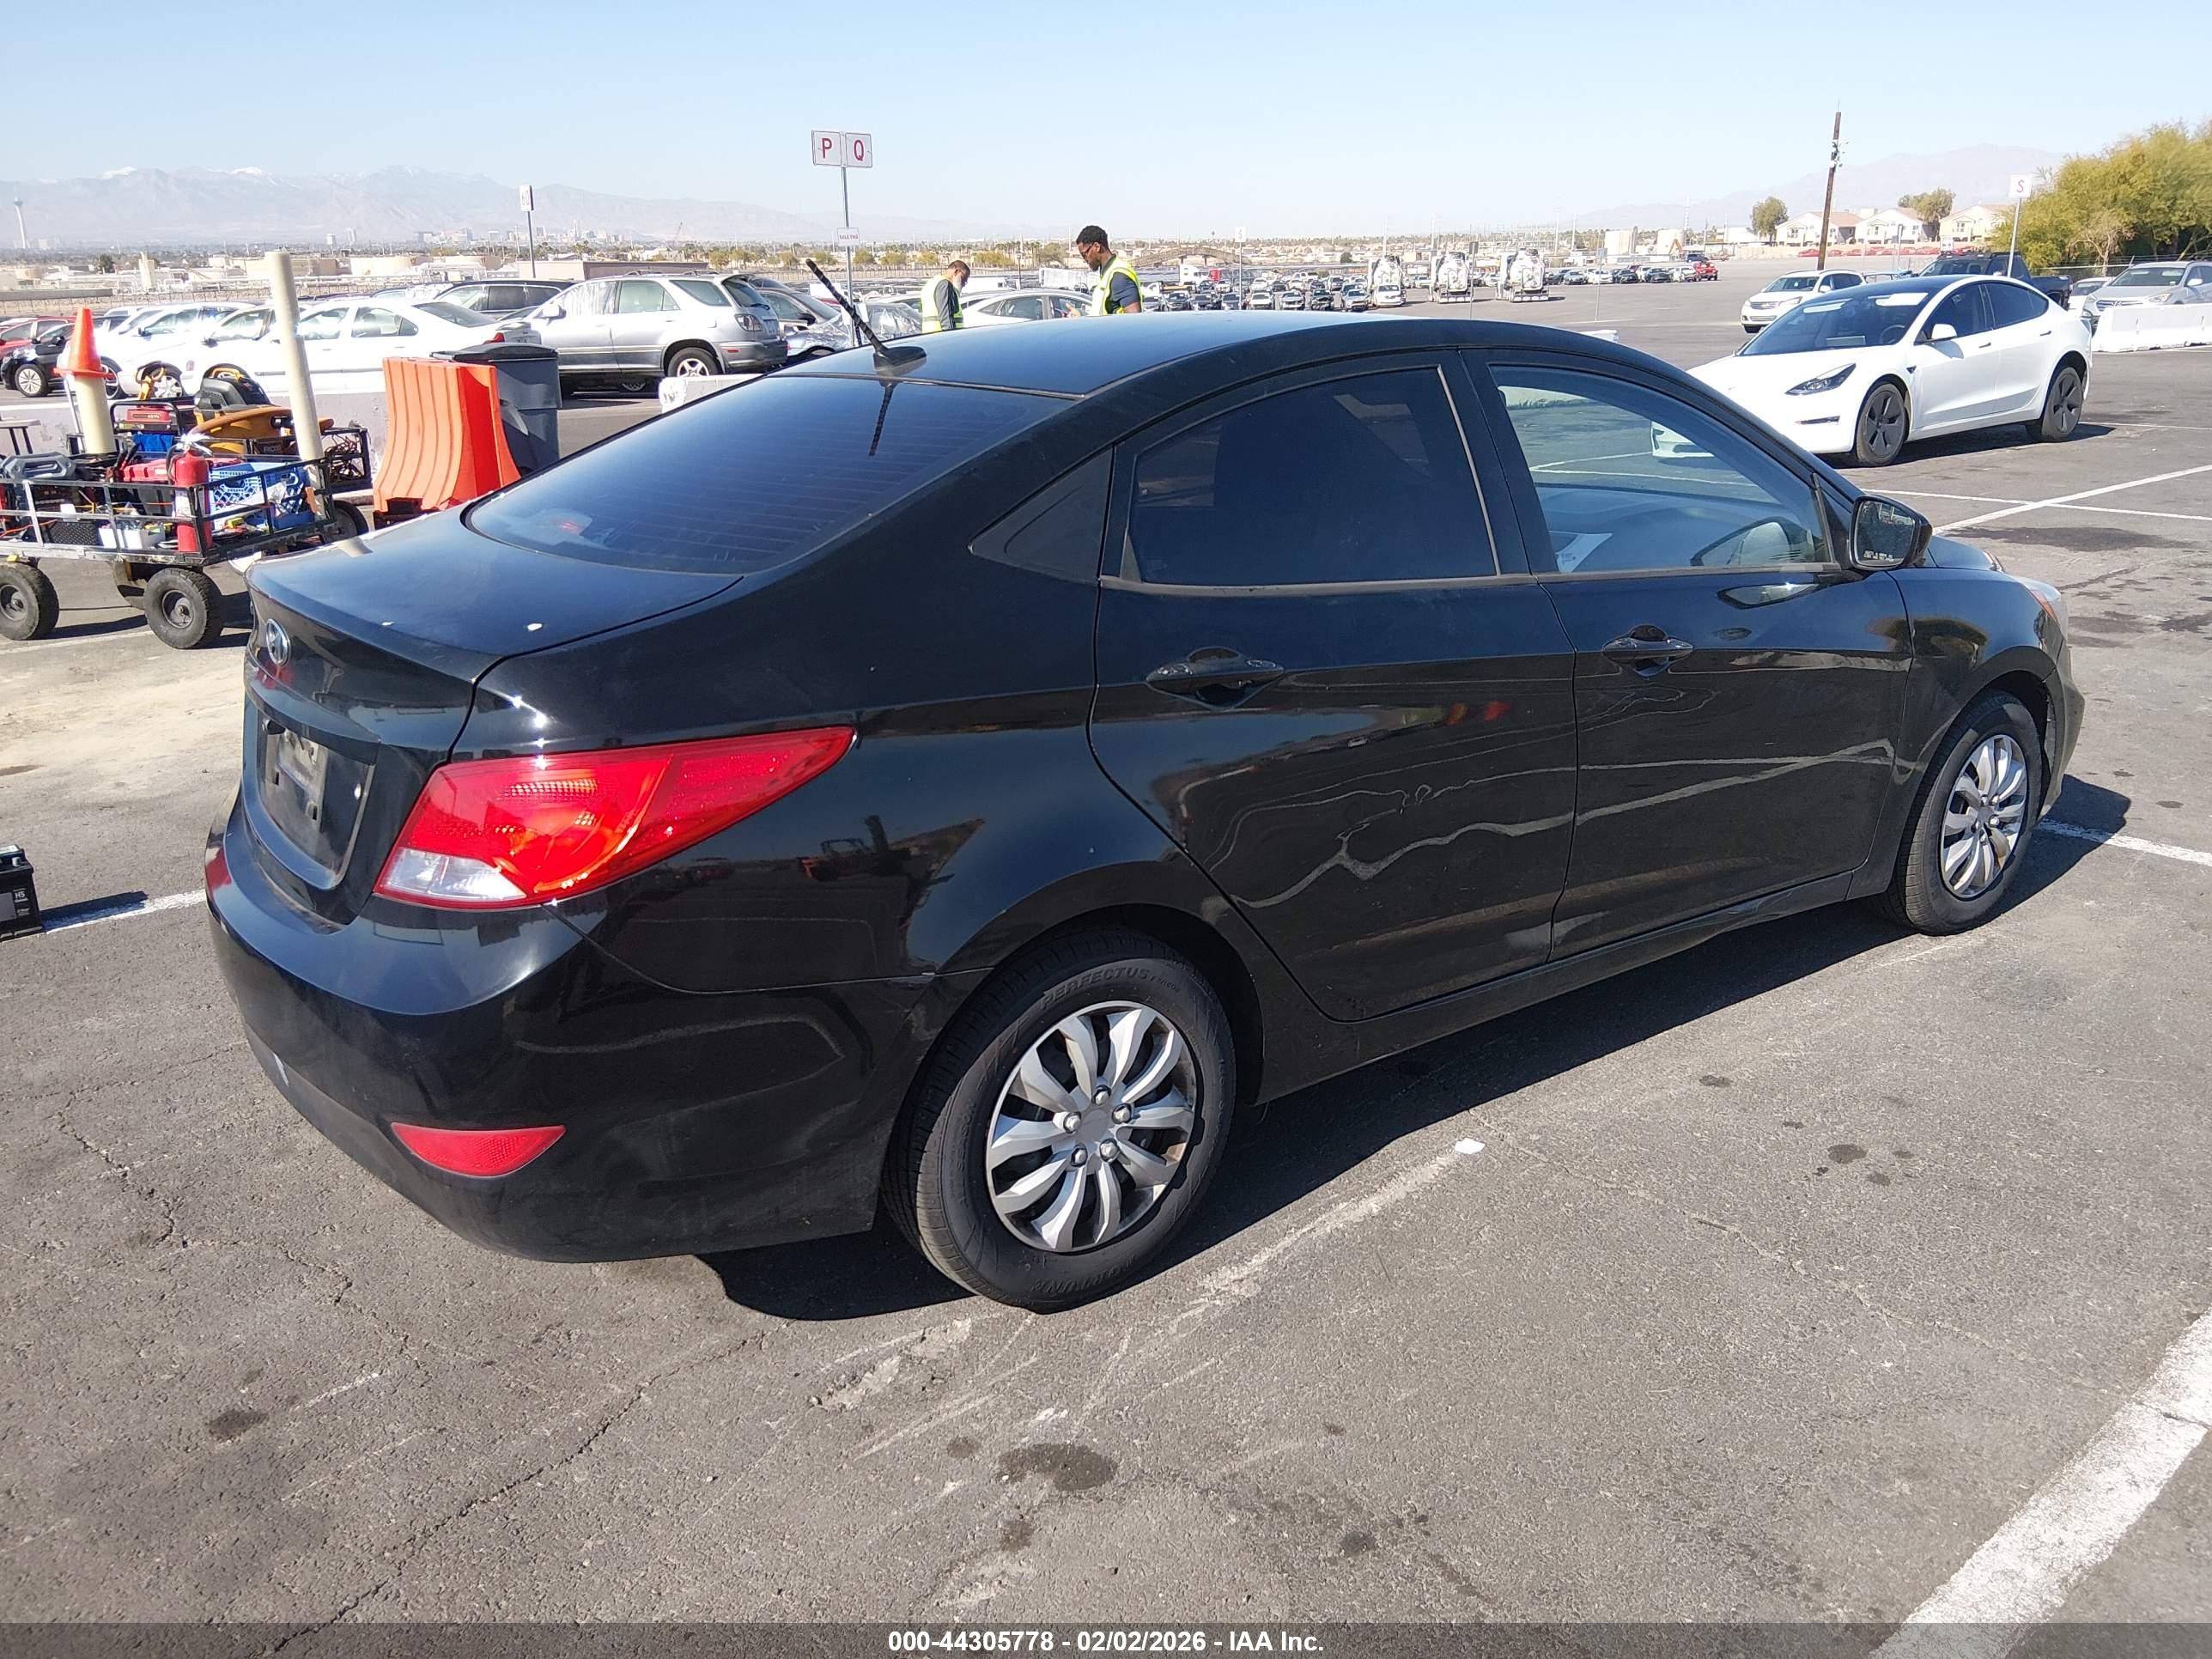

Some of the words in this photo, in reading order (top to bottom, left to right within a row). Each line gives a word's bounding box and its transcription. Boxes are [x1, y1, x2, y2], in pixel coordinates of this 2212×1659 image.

[821, 137, 833, 159] P
[854, 139, 865, 161] Q
[2016, 179, 2025, 193] S
[1040, 967, 1151, 1011] PERFECTUS
